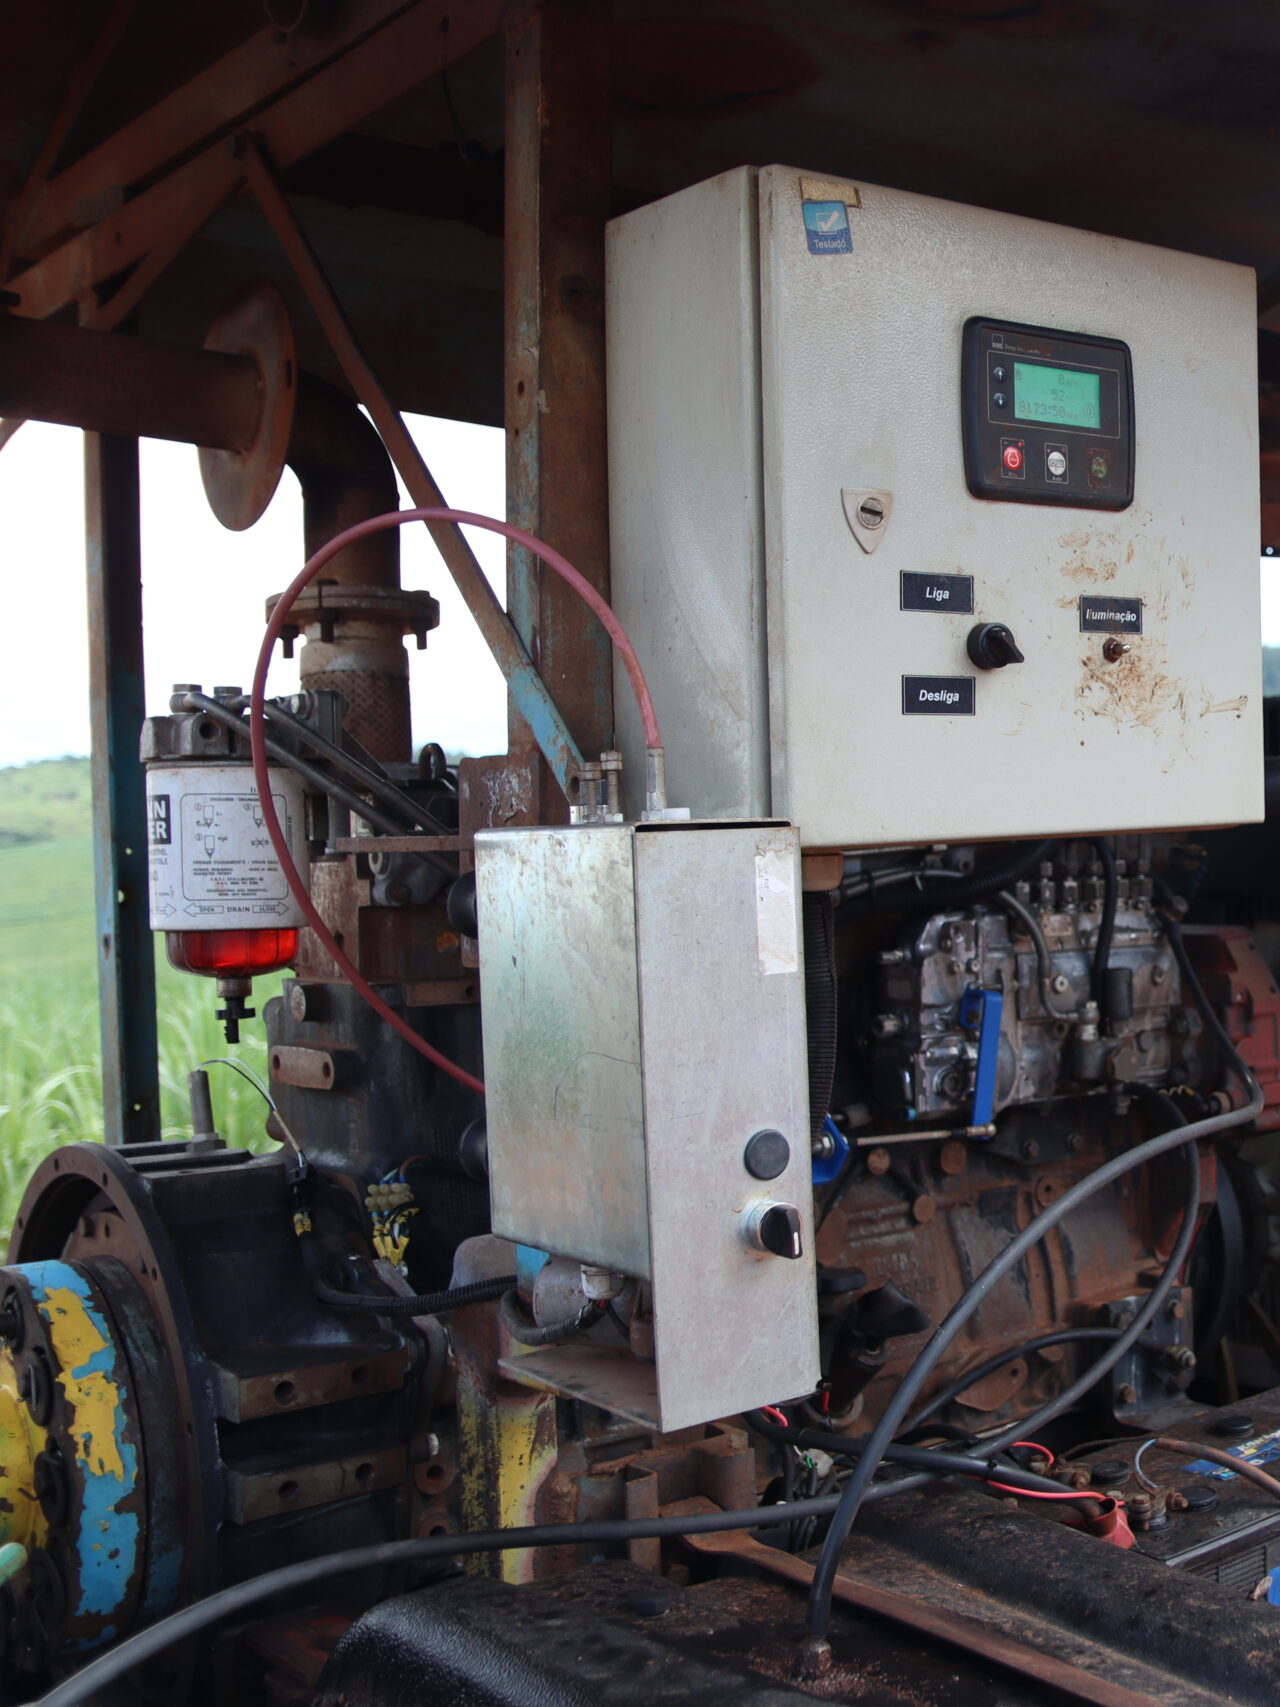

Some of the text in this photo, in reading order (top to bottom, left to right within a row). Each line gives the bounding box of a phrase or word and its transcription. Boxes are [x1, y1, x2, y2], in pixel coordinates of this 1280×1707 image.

[813, 238, 847, 249] Testado
[925, 586, 950, 602] Liga
[1086, 608, 1137, 622] Iluminação
[919, 689, 960, 704] Desliga
